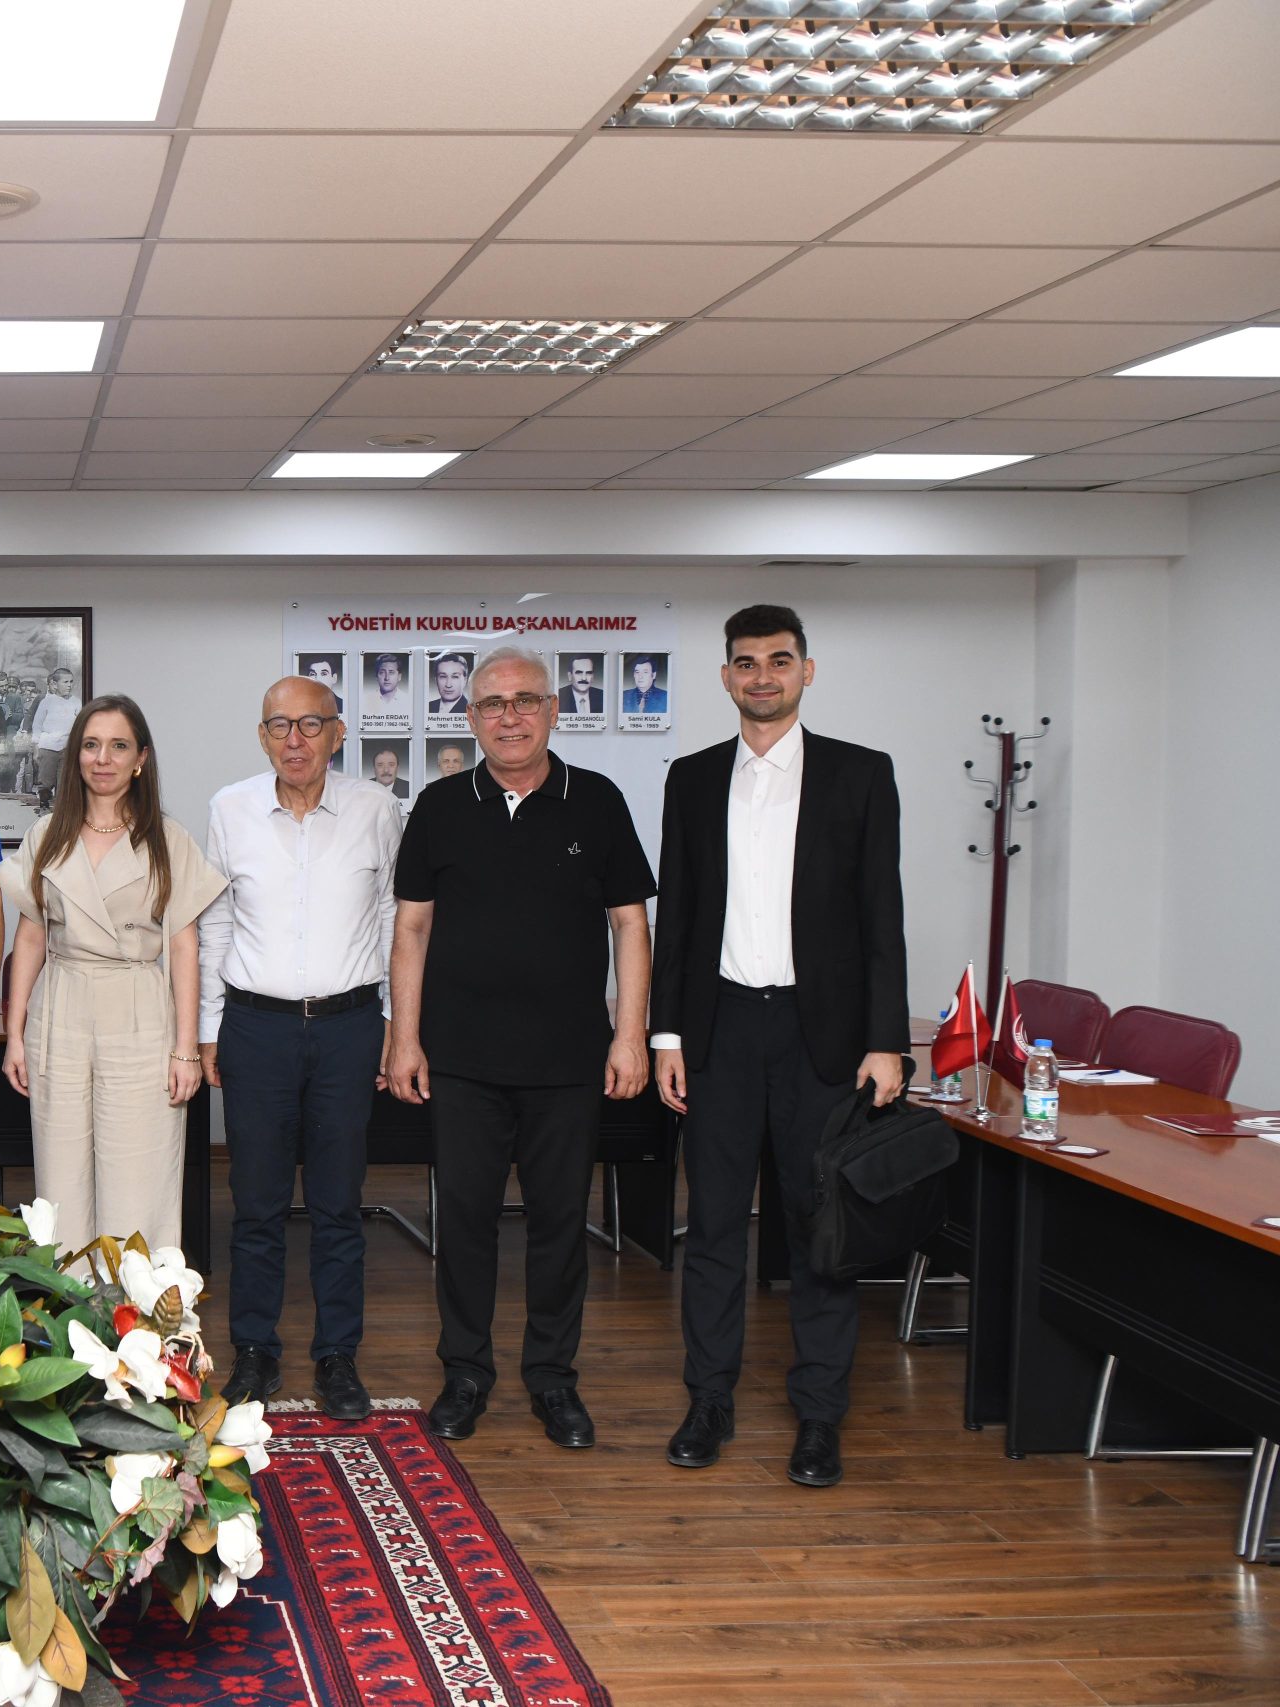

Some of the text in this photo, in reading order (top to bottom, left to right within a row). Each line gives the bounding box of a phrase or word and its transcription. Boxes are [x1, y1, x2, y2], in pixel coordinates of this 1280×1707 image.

[328, 613, 637, 635] YÖNETİM KURULU BAŞKANLARIMIZ
